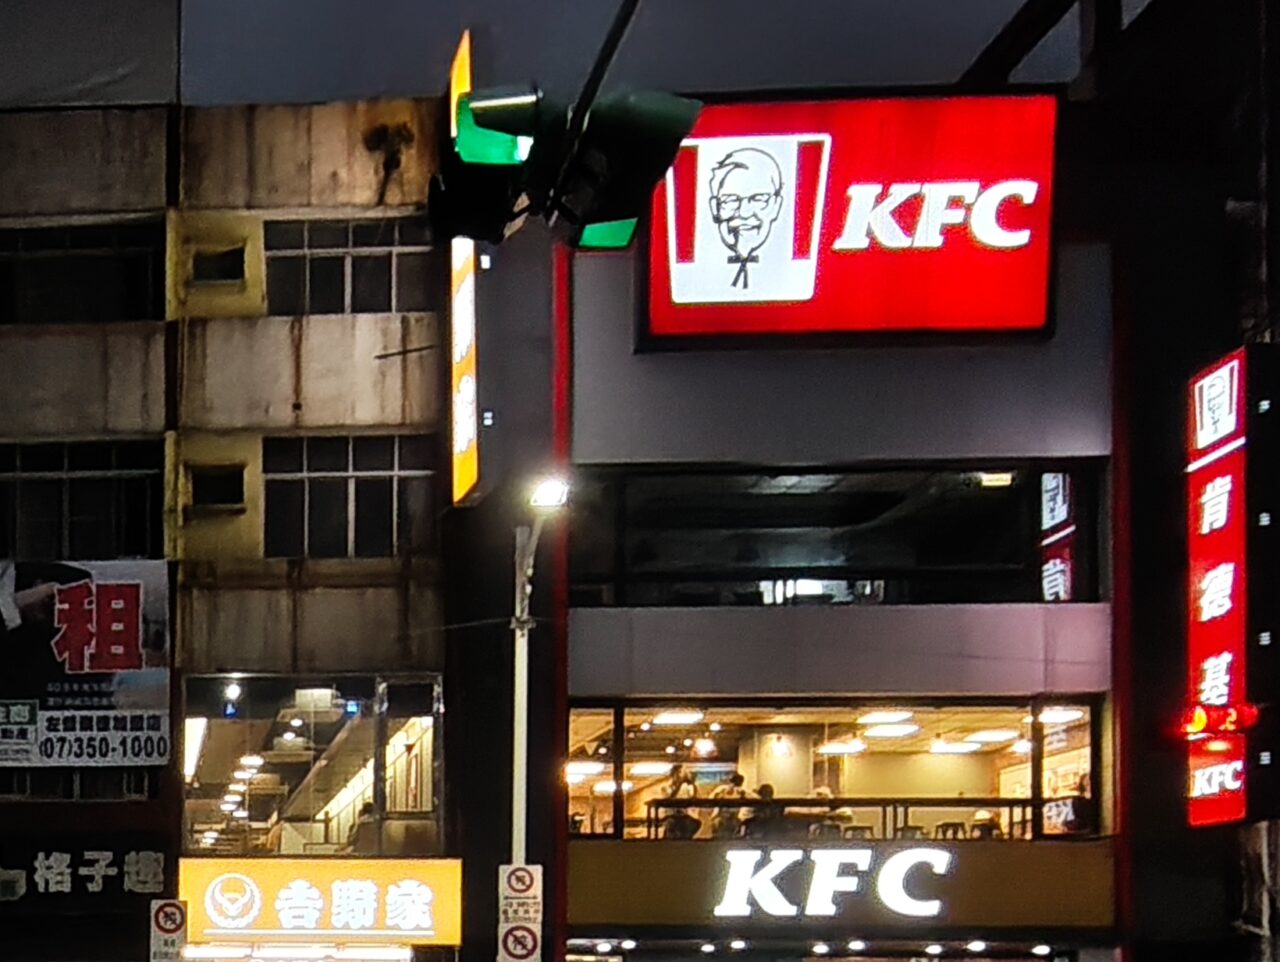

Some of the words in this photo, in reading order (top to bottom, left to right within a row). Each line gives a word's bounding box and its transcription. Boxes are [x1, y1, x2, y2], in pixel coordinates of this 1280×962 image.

[833, 181, 1038, 250] KFC
[1200, 474, 1235, 706] 肯德基
[51, 578, 145, 674] 租
[39, 736, 168, 759] (07)350-1000
[1189, 760, 1243, 798] KFC
[275, 879, 433, 930] 吉野家
[713, 848, 953, 917] KFC
